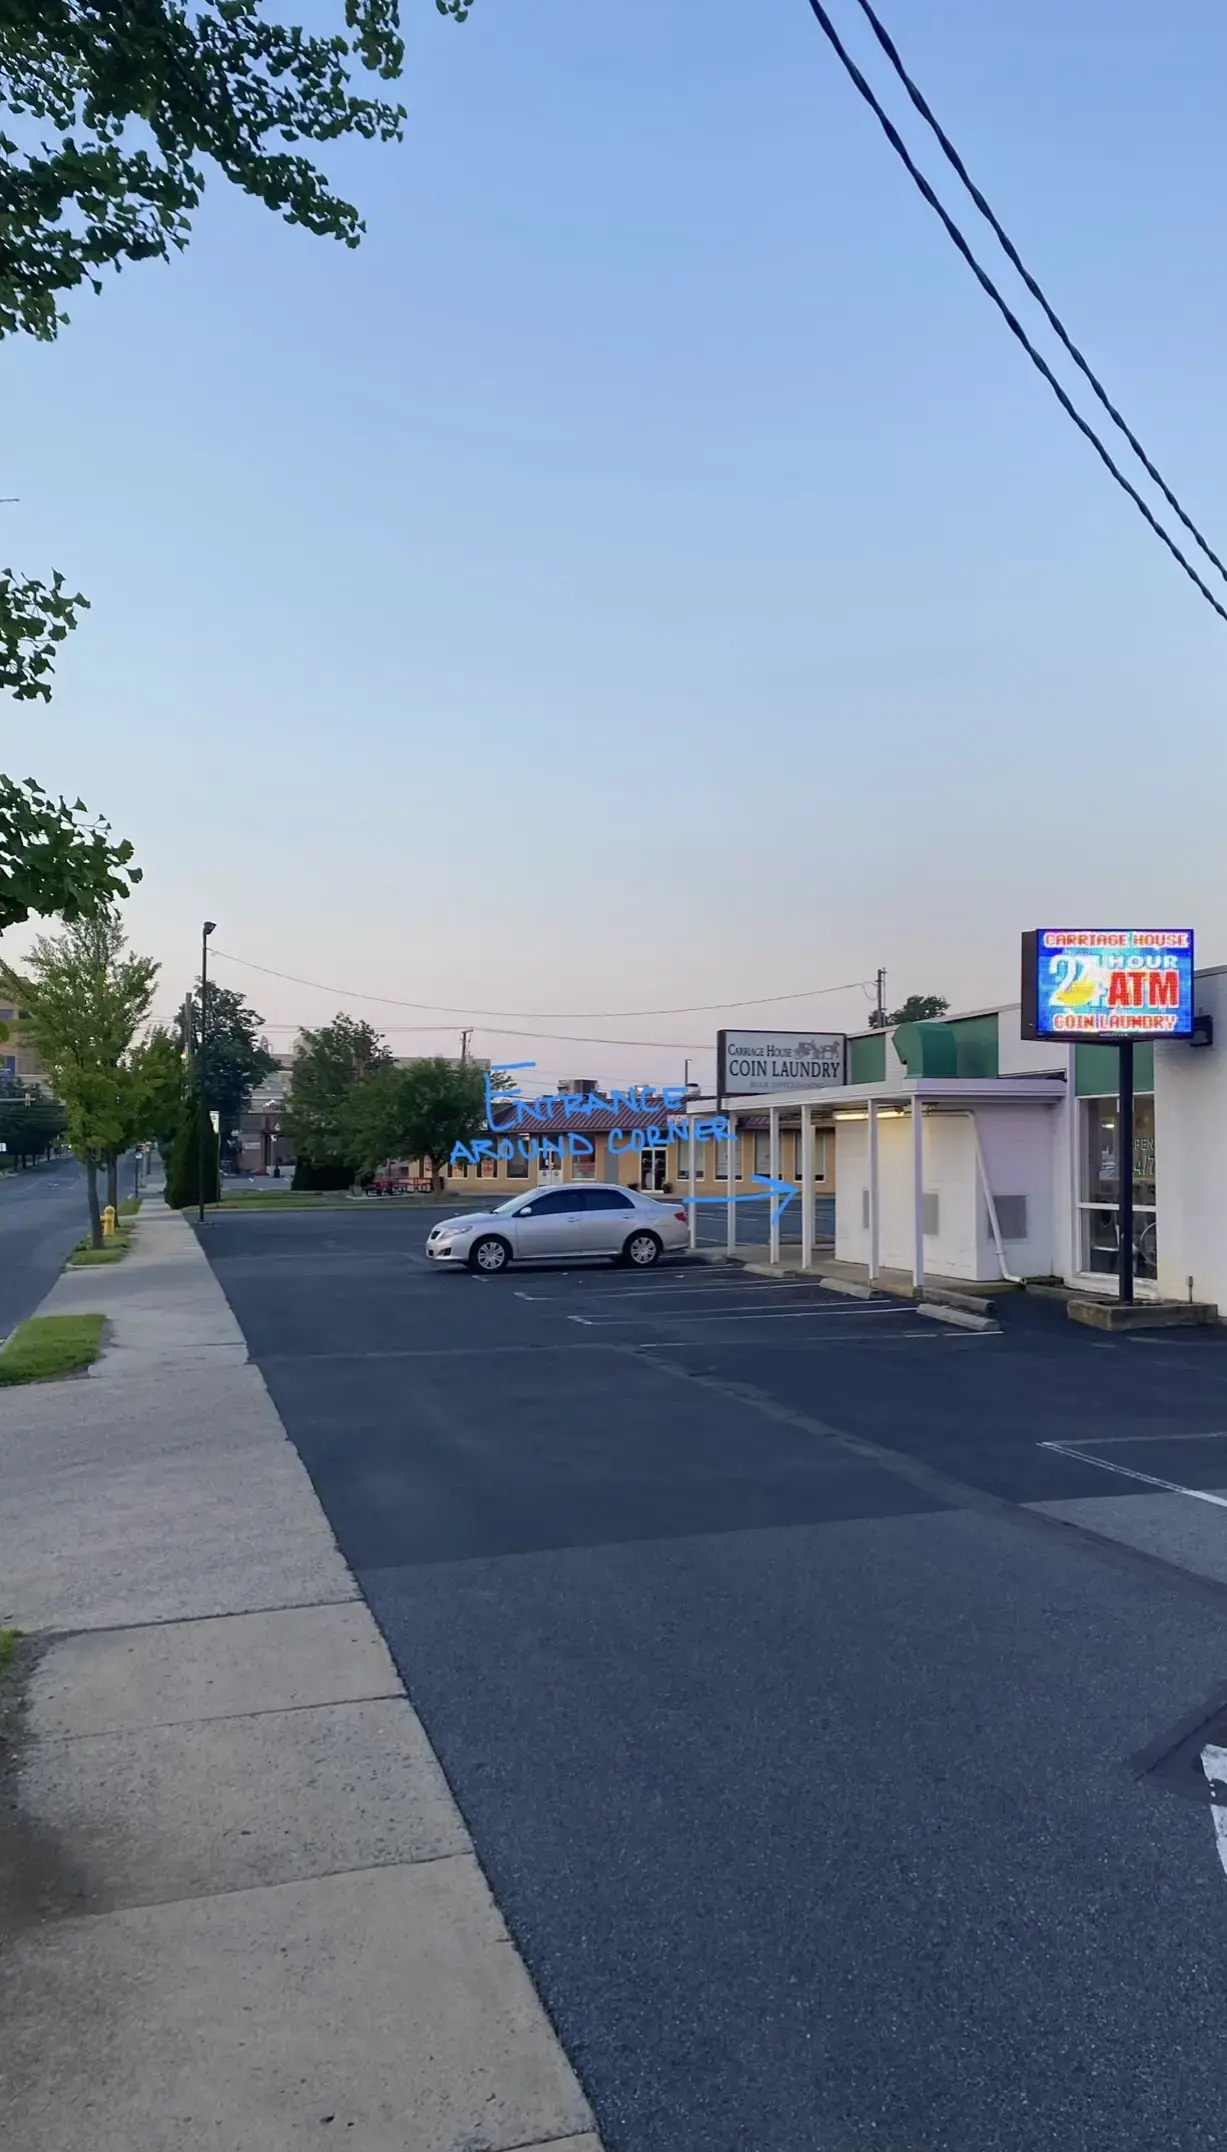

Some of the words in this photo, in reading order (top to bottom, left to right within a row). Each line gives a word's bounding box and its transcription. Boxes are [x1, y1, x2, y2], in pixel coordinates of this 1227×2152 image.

[1045, 934, 1127, 946] CARRIAGE
[1133, 934, 1187, 946] HOUSE
[1108, 955, 1178, 968] HOUR
[1107, 971, 1179, 1006] ATM
[1053, 1015, 1094, 1029] COIN
[1099, 1015, 1176, 1029] LAUNDRY
[729, 1060, 767, 1077] COIN
[772, 1061, 840, 1078] LAUNDRY
[1131, 1137, 1155, 1151] PEN
